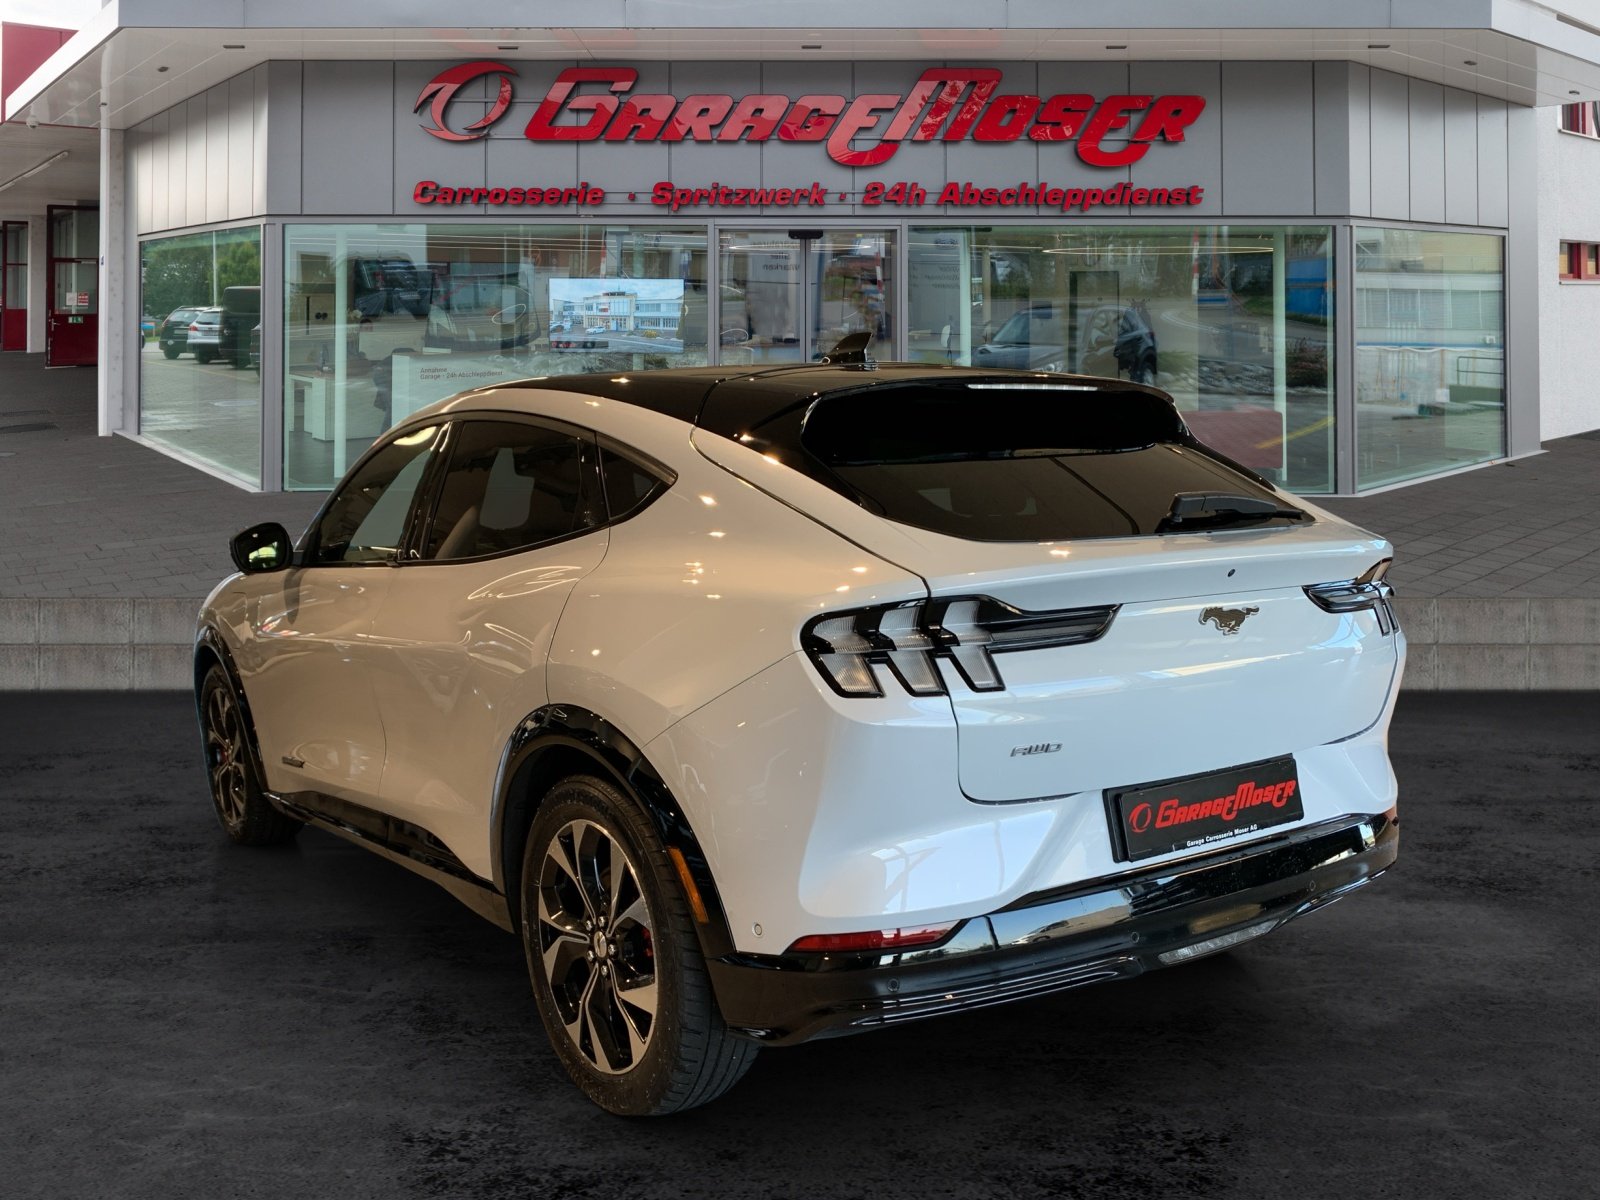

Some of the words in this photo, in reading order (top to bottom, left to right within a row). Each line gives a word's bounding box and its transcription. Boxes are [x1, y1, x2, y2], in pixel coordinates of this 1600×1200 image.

[413, 181, 604, 206] Carrosserie
[651, 182, 827, 211] Spritzwerk
[863, 182, 927, 206] 24h
[937, 182, 1204, 211] Abschleppdienst
[458, 370, 503, 379] Abschleppdienst
[1186, 838, 1205, 847] Garage
[1205, 831, 1234, 842] Carrosserie
[1234, 826, 1249, 835] Moser
[1250, 823, 1258, 831] AG
